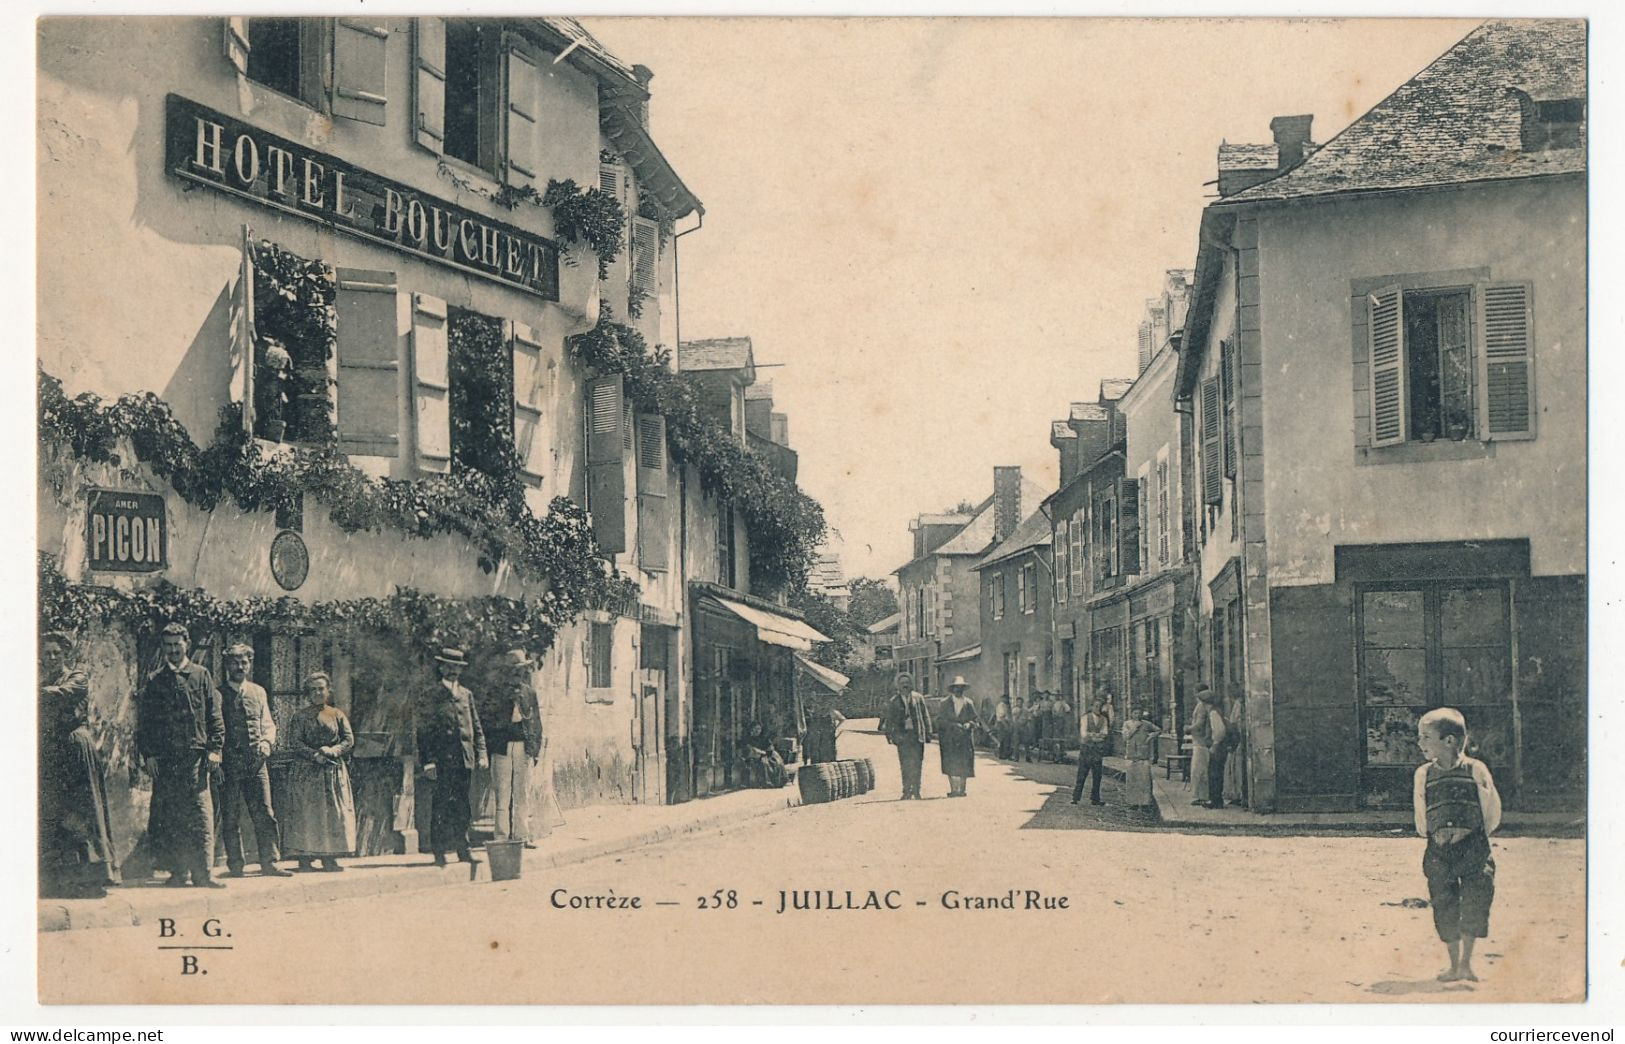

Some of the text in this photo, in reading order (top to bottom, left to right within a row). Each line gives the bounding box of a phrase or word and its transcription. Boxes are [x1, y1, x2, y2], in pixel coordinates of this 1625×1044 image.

[192, 117, 546, 283] HOTEL BOUCHET
[115, 499, 139, 510] AMER
[92, 513, 161, 563] PICON
